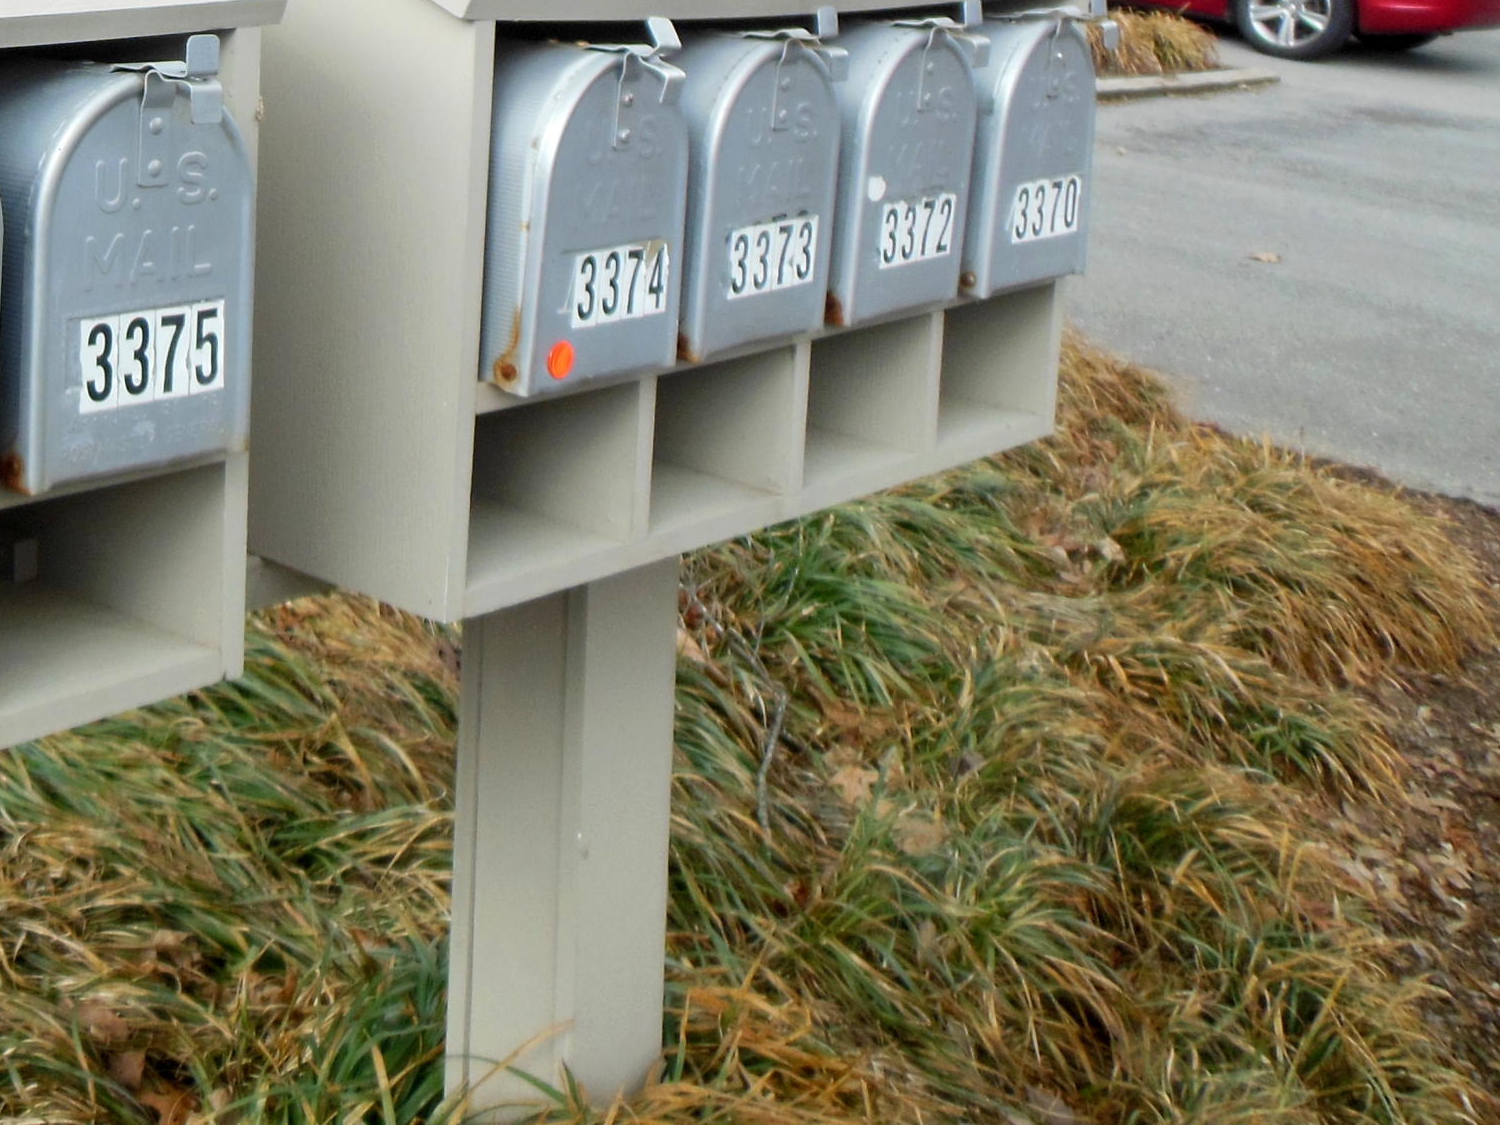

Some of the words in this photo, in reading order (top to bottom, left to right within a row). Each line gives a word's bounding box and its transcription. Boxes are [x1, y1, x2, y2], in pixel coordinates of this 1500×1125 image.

[883, 199, 951, 263] 3372
[1015, 178, 1077, 239] 3370
[83, 225, 212, 292] MAIL
[578, 243, 664, 320] 3374
[732, 221, 812, 294] 3373
[86, 309, 218, 403] 3375
